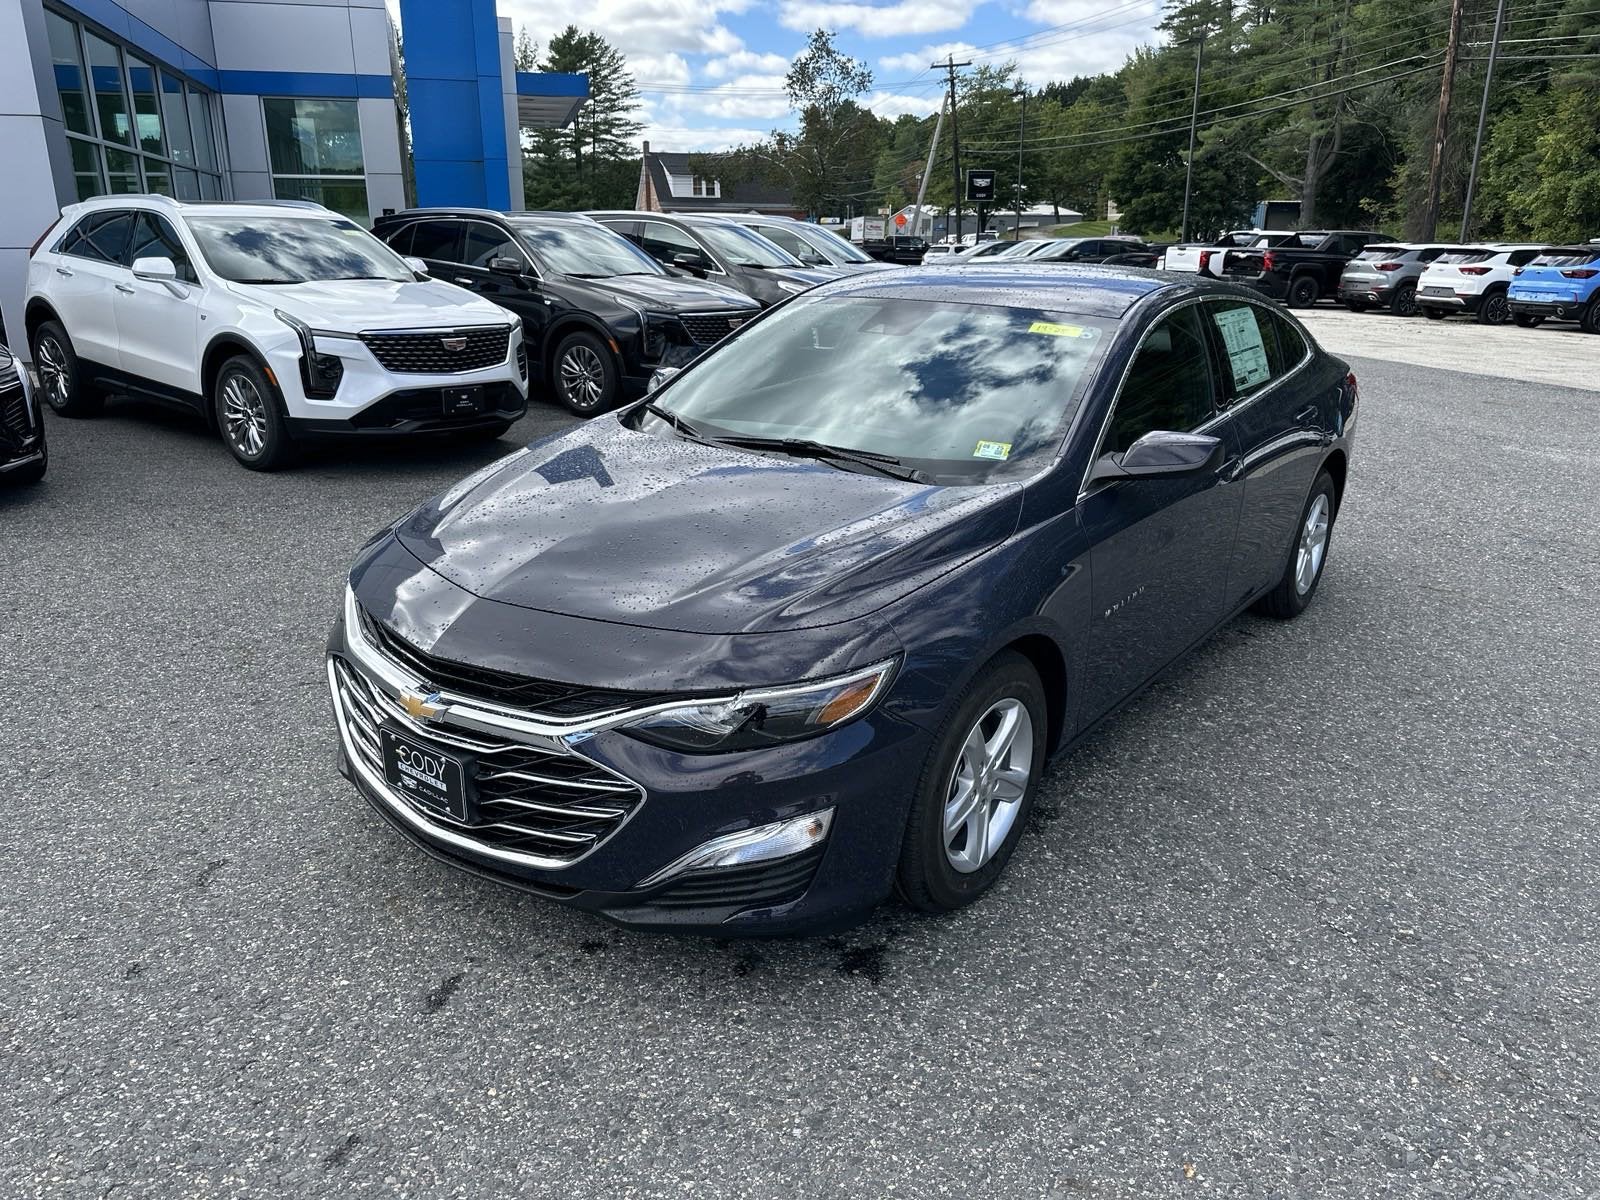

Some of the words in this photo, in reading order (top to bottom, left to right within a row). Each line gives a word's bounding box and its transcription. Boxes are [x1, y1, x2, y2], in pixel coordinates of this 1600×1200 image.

[399, 745, 446, 781] CODY
[400, 763, 444, 789] CHEVROLET
[419, 785, 449, 804] CADILLAC
